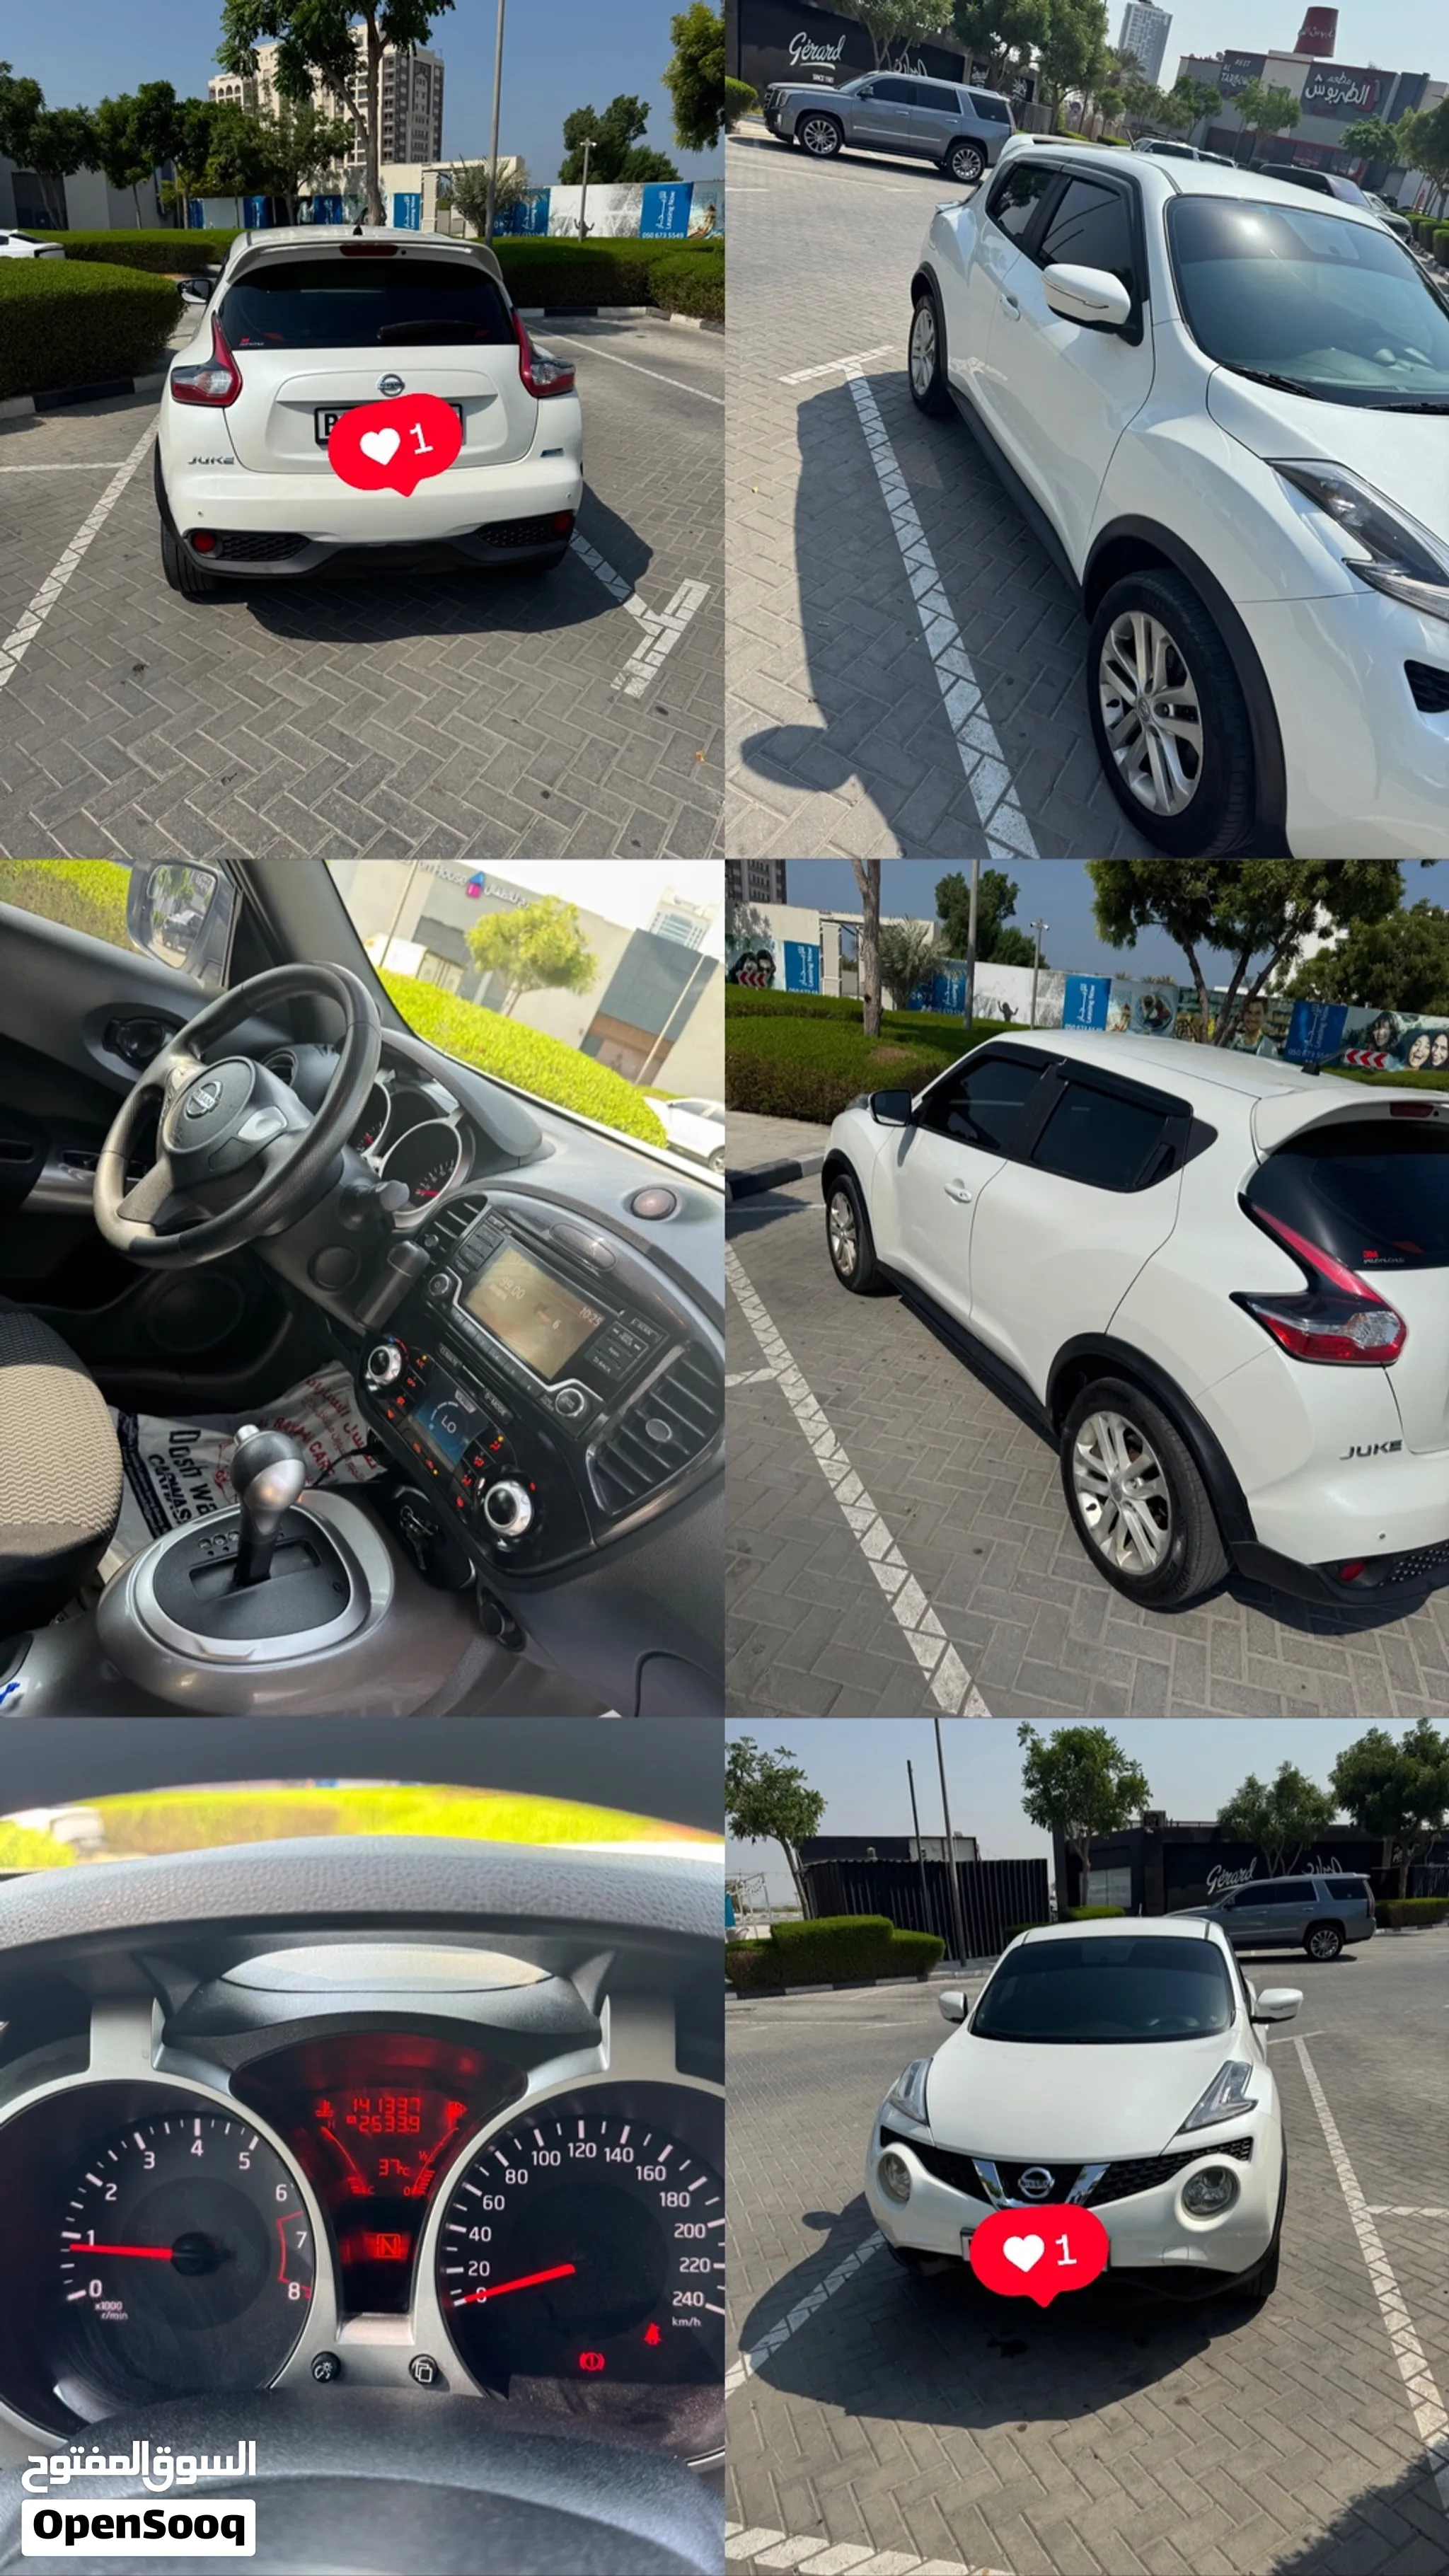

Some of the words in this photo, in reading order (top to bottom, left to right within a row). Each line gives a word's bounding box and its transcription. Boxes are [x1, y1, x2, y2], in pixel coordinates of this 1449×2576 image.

[789, 31, 846, 66] Gérard
[1305, 74, 1371, 105] الطربوش
[665, 207, 675, 230] Leasing
[187, 456, 235, 465] JUKE
[579, 1306, 601, 1327] 10:25
[1339, 1439, 1403, 1461] JUKE
[353, 2096, 420, 2113] 141337
[190, 2139, 203, 2156] 4
[568, 2142, 597, 2158] 120
[604, 2147, 635, 2163] 140
[143, 2152, 156, 2169] 3
[238, 2152, 250, 2170] 5
[531, 2150, 561, 2166] 100
[505, 2169, 529, 2185] 80
[636, 2165, 666, 2181] 160
[105, 2183, 117, 2201] 2
[275, 2184, 287, 2202] 6
[659, 2192, 691, 2207] 180
[482, 2195, 506, 2211] 60
[86, 2229, 95, 2246] 1
[468, 2226, 492, 2242] 40
[674, 2223, 706, 2239] 200
[296, 2231, 308, 2248] 7
[381, 2236, 398, 2252] N
[468, 2261, 490, 2277] 20
[679, 2257, 711, 2272] 220
[89, 2280, 103, 2297] 0
[288, 2282, 301, 2300] 8
[672, 2291, 705, 2306] 240
[101, 2311, 129, 2321] r/min
[671, 2316, 702, 2328] km/h
